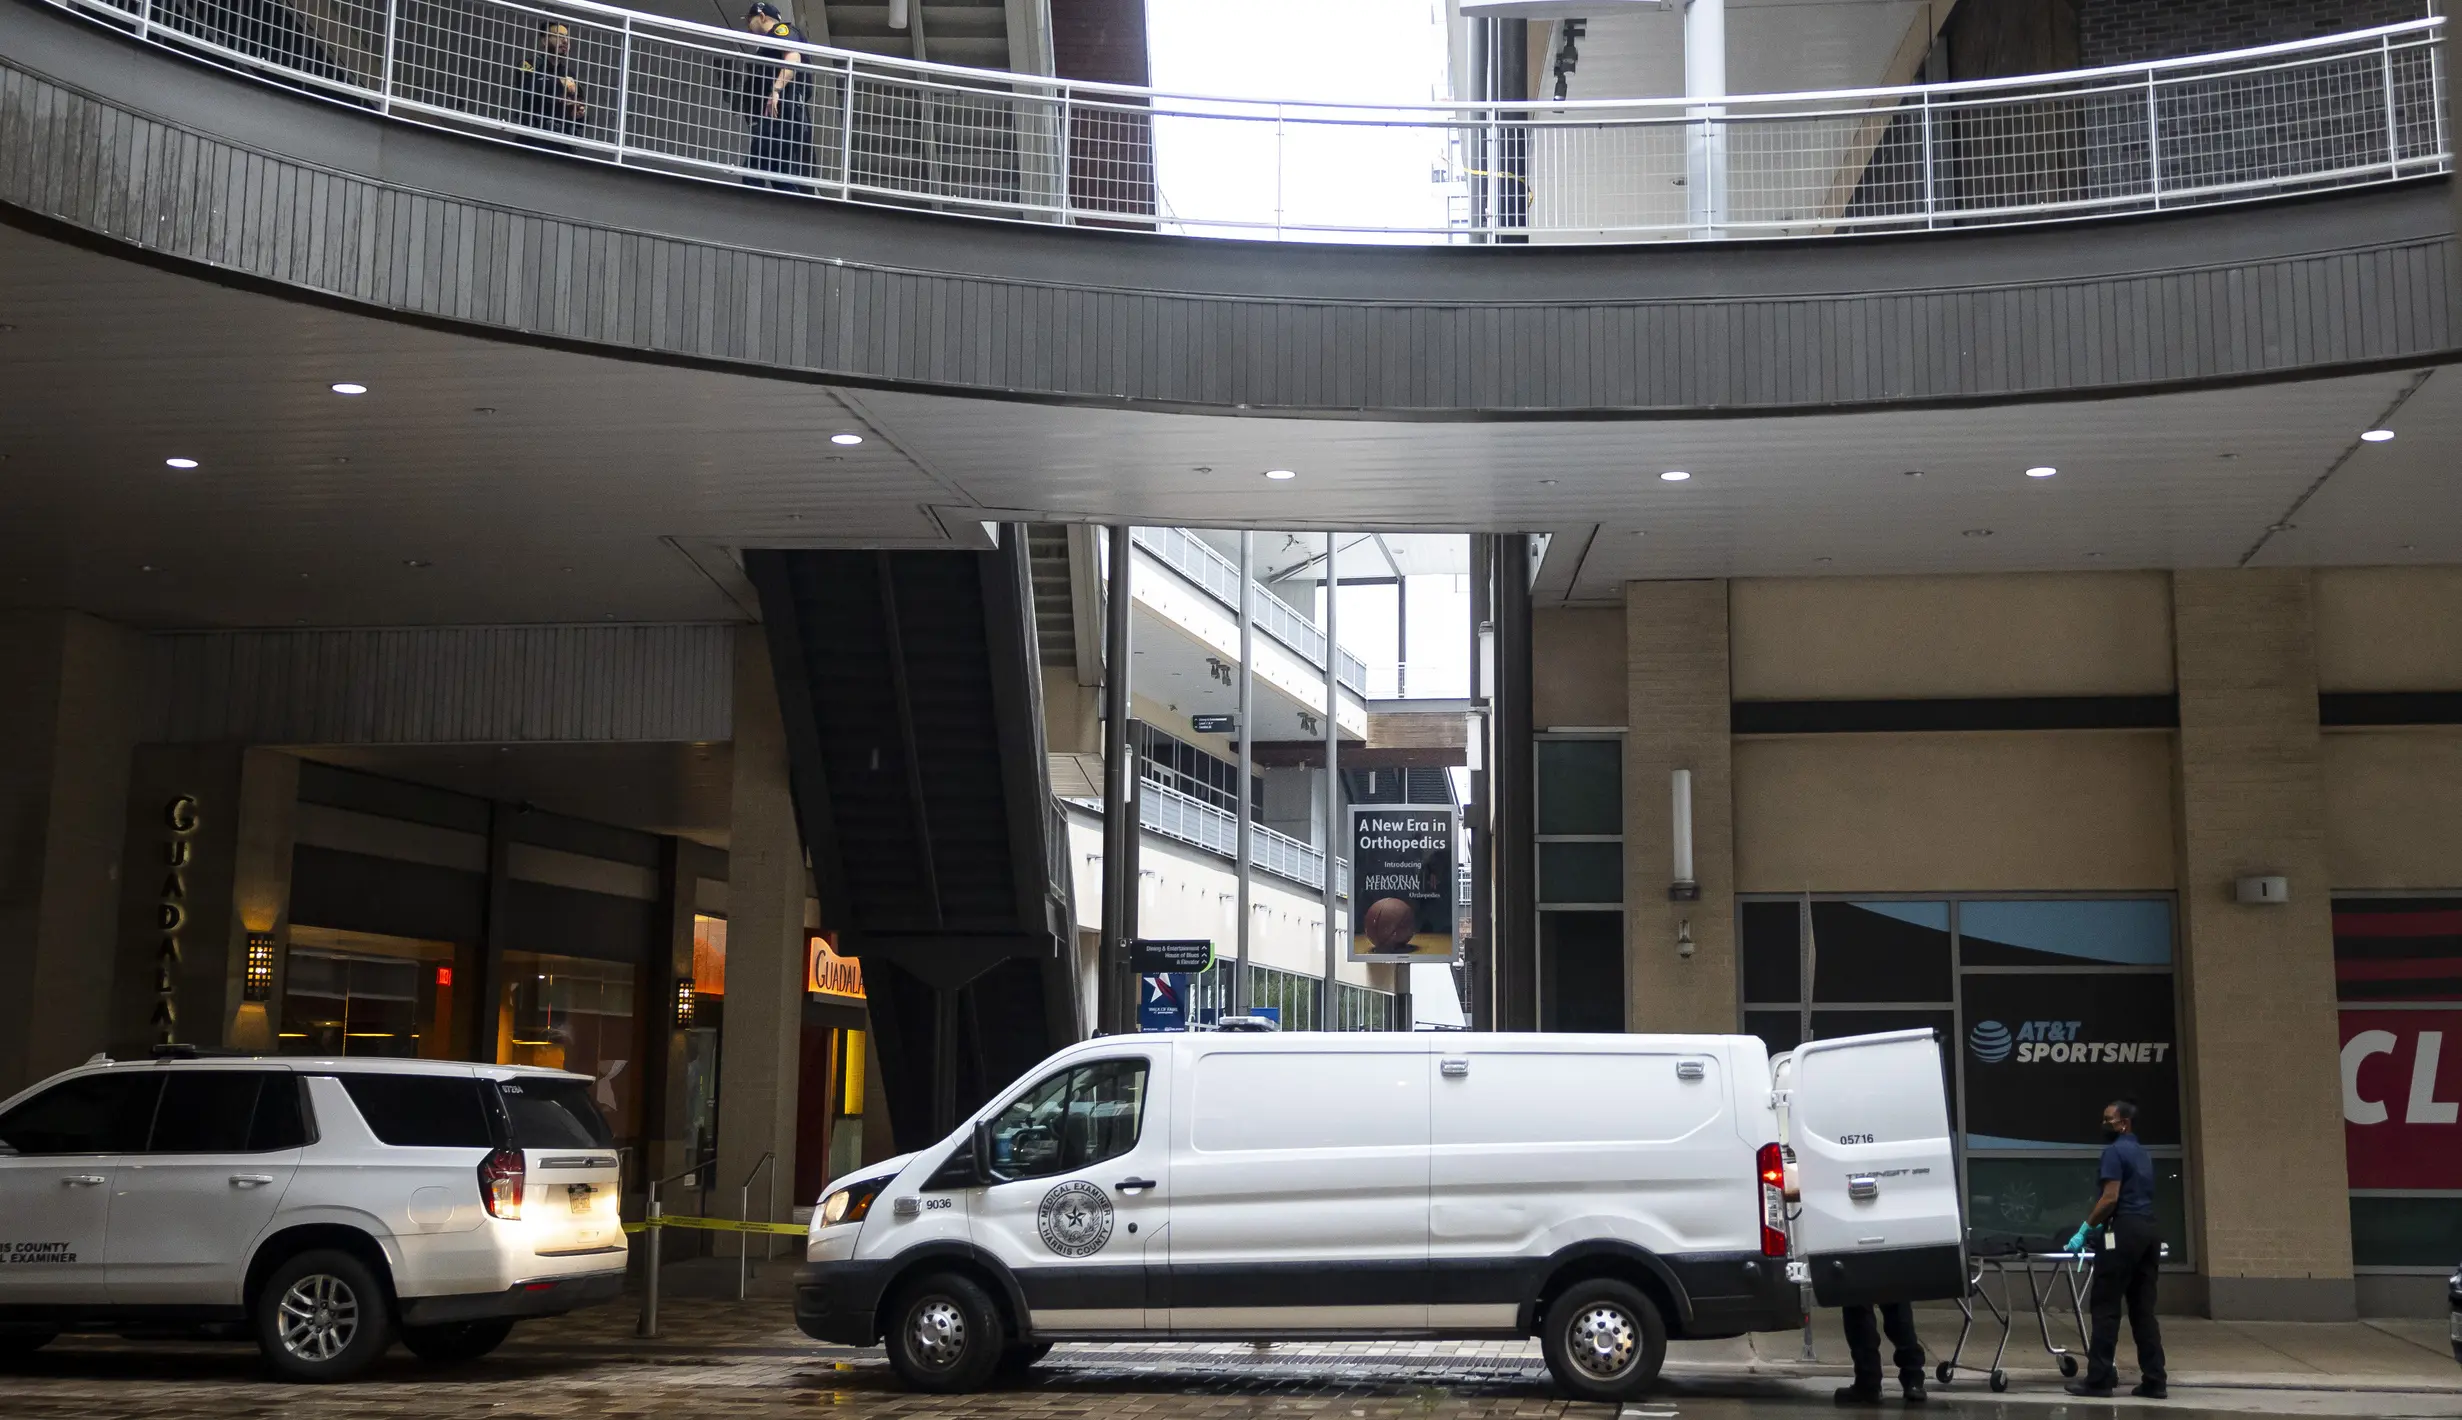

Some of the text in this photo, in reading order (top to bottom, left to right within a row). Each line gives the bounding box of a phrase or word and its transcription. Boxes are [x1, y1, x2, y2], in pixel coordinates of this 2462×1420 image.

[1359, 818, 1446, 832] A New Era in
[1360, 836, 1446, 852] Orthopedics
[1384, 861, 1422, 869] Introducing
[1365, 874, 1420, 884] MEMORIAL
[1365, 881, 1420, 890] HERMANN
[2016, 1021, 2082, 1041] AT&T
[2016, 1042, 2170, 1063] SPORTSNET
[2340, 1029, 2460, 1125] CL
[1840, 1134, 1874, 1145] 05716
[926, 1198, 952, 1210] 9036
[1041, 1183, 1111, 1218] MEDICAL EXAMINER
[15, 1242, 71, 1252] COUNTY
[1043, 1227, 1109, 1256] HARRIS COUNTY
[10, 1253, 77, 1262] EXAMINER
